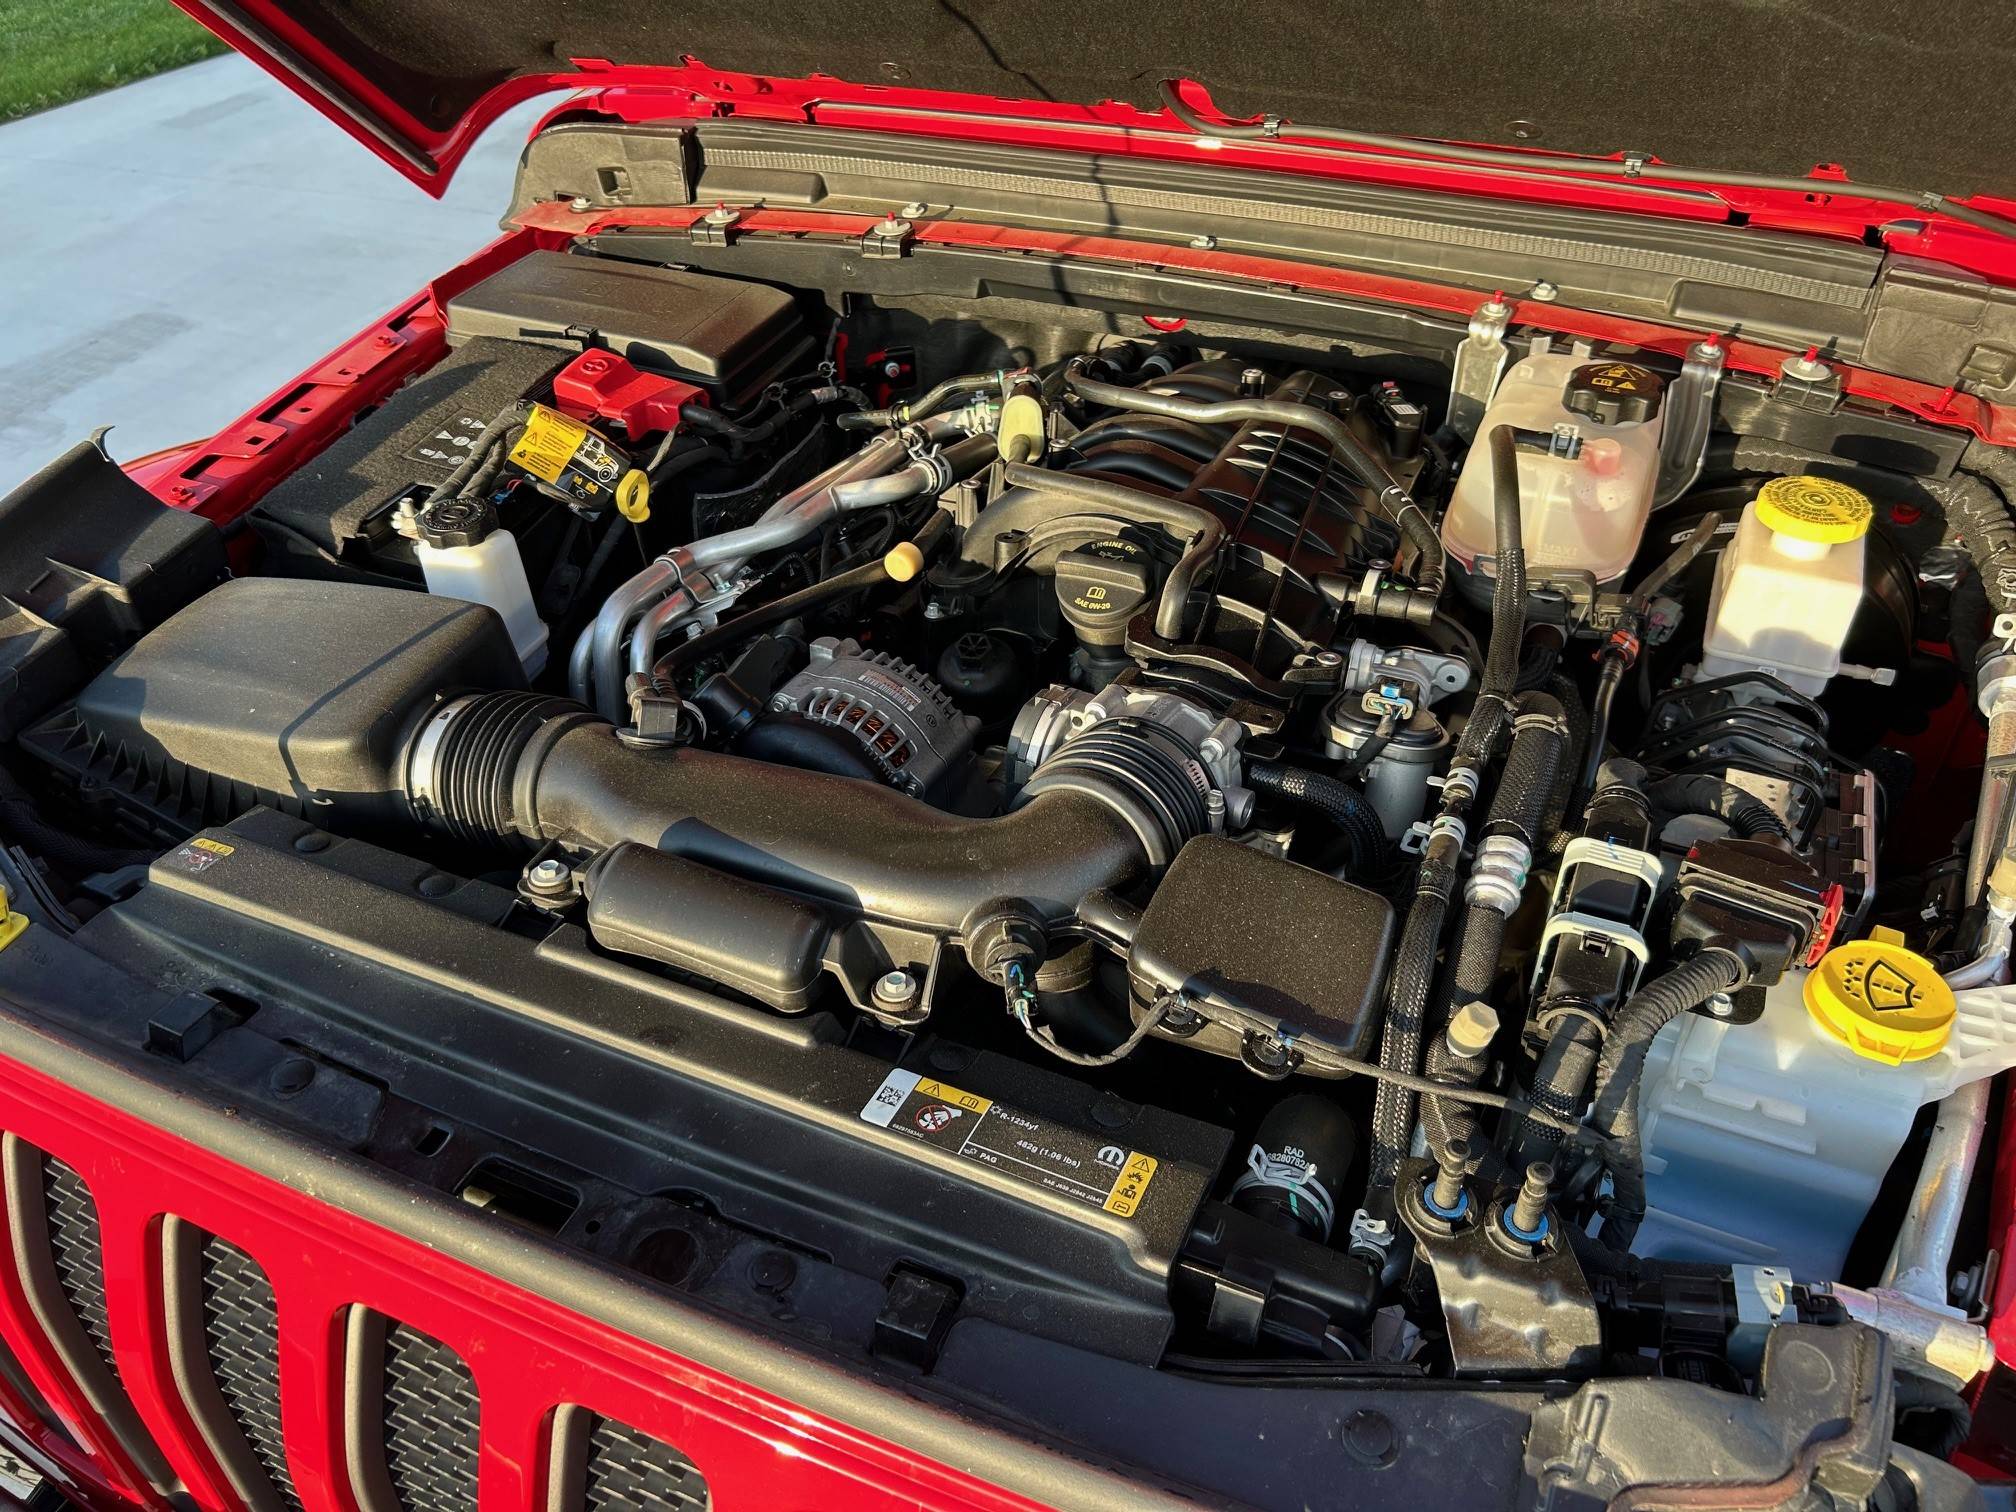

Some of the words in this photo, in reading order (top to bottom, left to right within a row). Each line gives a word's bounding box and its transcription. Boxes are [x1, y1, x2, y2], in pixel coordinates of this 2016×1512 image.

[1091, 541, 1124, 550] ENGINE
[1125, 545, 1137, 555] OIL
[1074, 597, 1089, 608] SAE
[1088, 602, 1111, 610] 0W-20
[1000, 1112, 1039, 1131] R-1234yf
[979, 1152, 998, 1164] PAG
[1016, 1140, 1038, 1153] 482g
[1039, 1147, 1062, 1161] (1.06
[1063, 1156, 1081, 1169] lbs)
[1284, 1145, 1304, 1159] RAD
